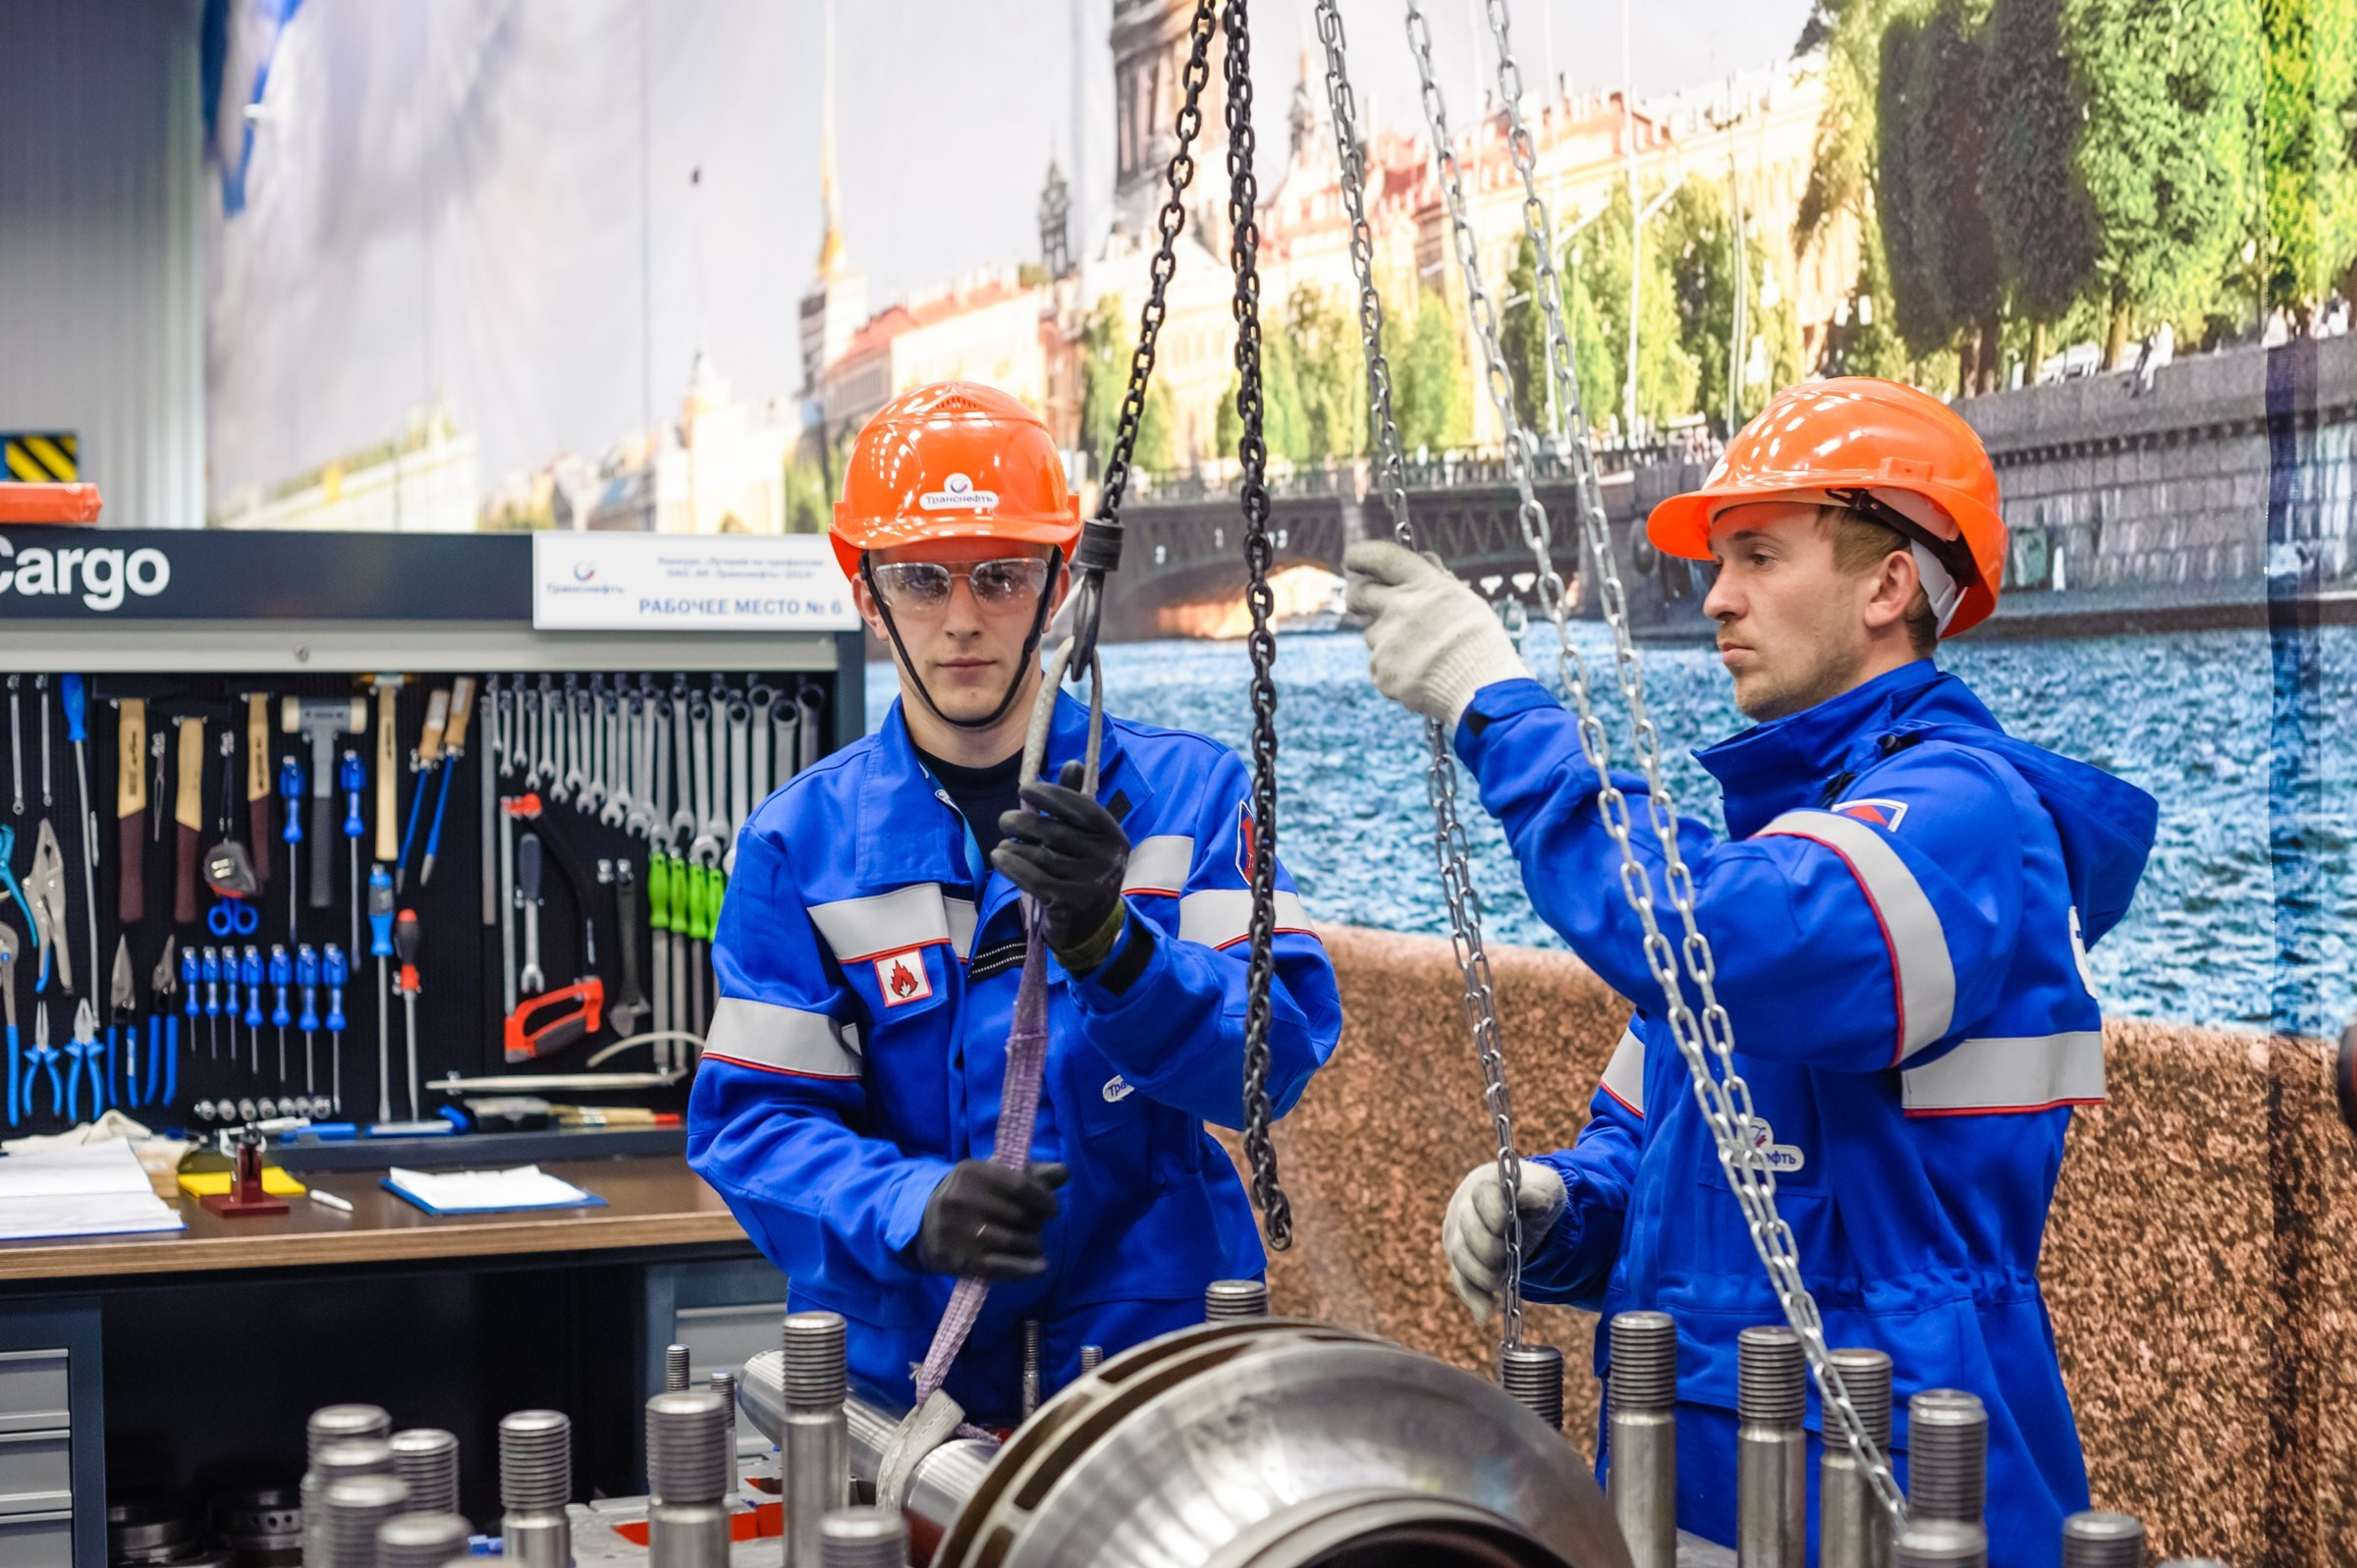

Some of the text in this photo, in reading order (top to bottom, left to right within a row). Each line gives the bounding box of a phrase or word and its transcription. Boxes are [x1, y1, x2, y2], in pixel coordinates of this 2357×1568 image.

[926, 495, 993, 505] Транснефть
[0, 534, 170, 611] argo
[638, 598, 727, 616] РАБОЧЕЕ
[735, 599, 800, 615] МЕСТО
[830, 600, 844, 615] 6
